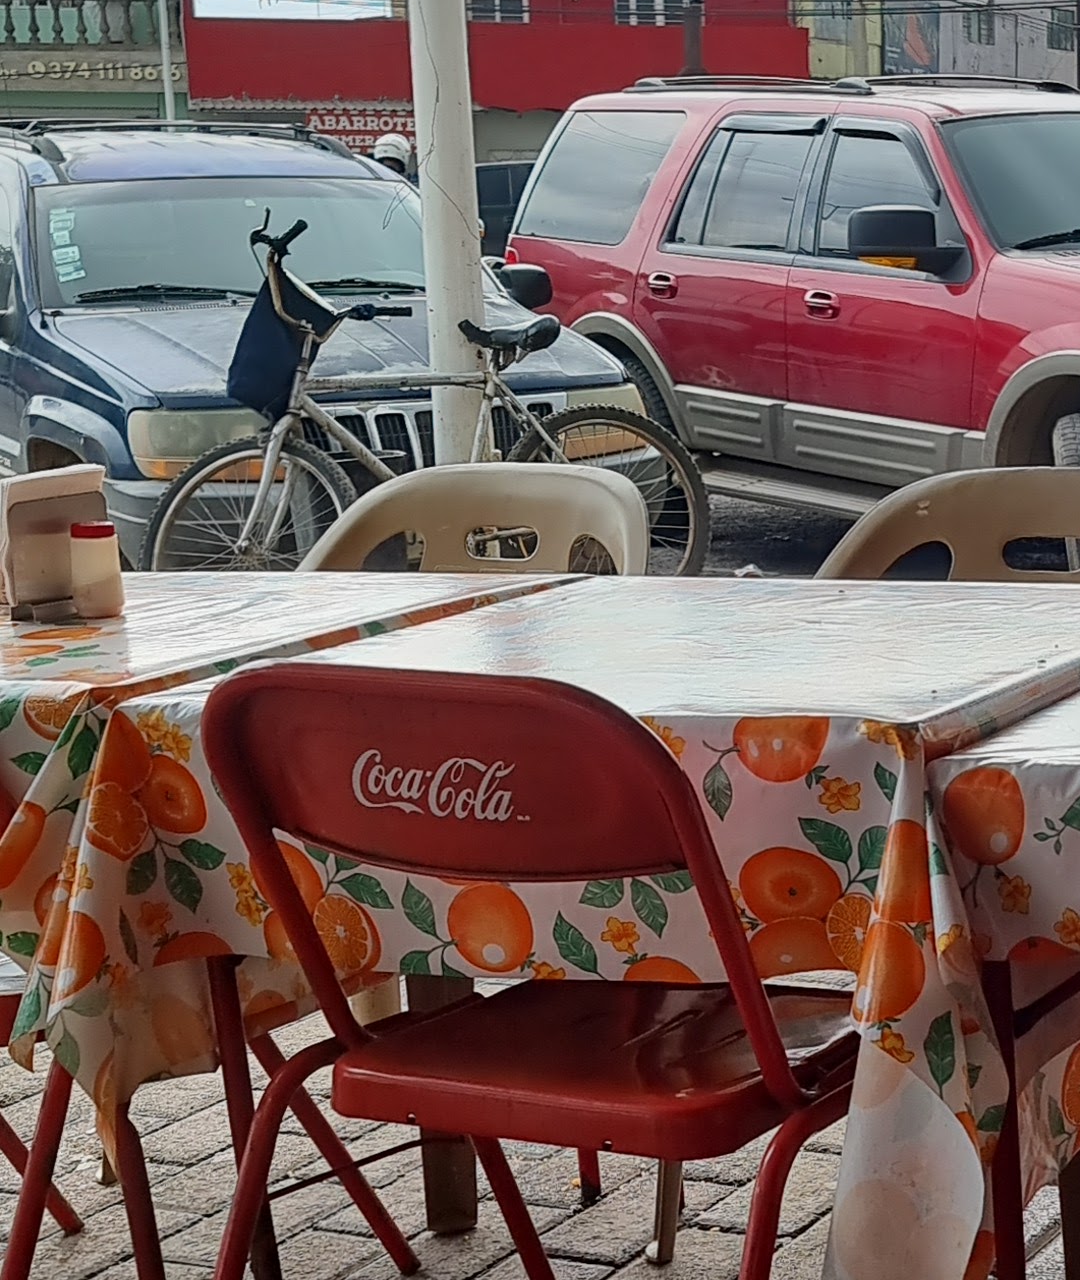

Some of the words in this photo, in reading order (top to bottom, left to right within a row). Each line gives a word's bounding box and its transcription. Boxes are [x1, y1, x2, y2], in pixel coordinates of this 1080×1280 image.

[48, 62, 91, 80] 374
[97, 63, 124, 80] 111
[130, 64, 182, 81] 866
[352, 749, 515, 821] Coca-Cola
